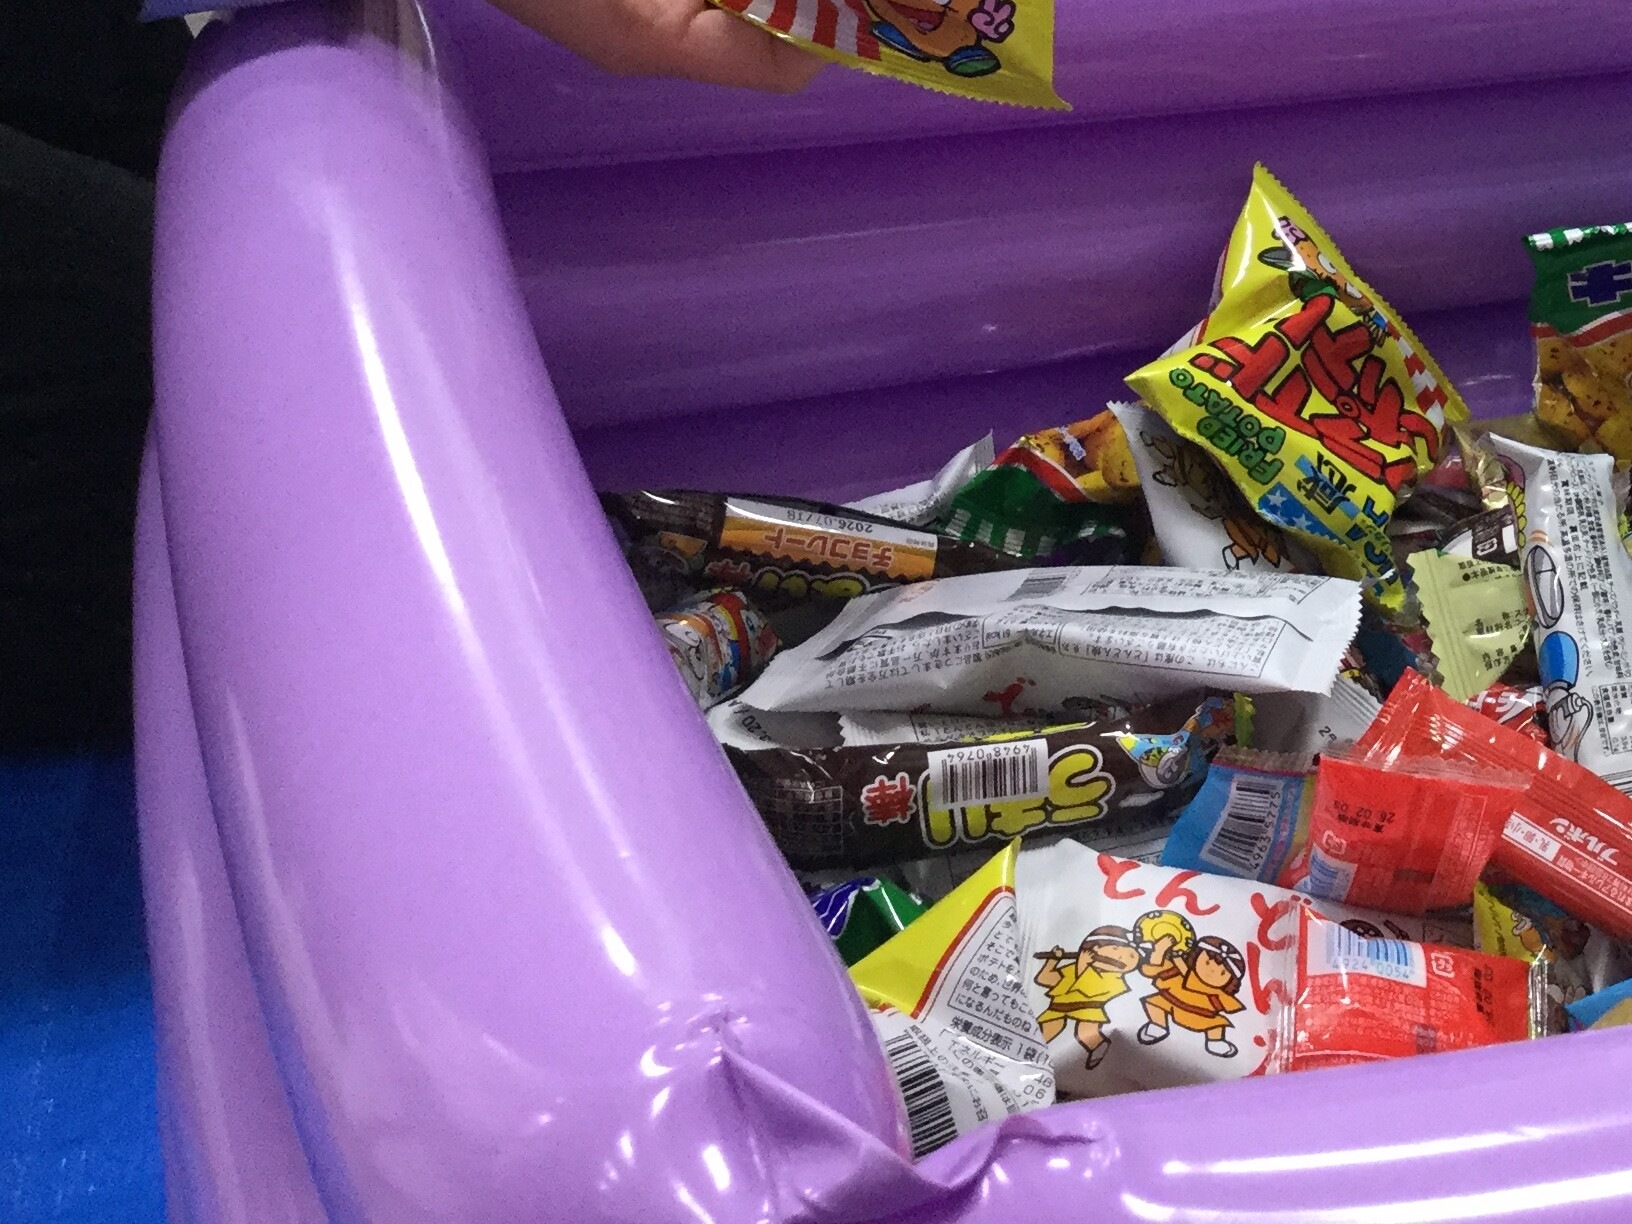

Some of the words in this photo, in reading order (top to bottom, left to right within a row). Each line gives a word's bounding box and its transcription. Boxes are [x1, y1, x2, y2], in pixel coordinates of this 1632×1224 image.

[1169, 368, 1286, 455] POTATO
[1197, 415, 1285, 485] FRIED
[764, 527, 893, 569] チョコレート
[947, 748, 984, 763] 0764
[993, 744, 1031, 758] 4948
[1546, 813, 1624, 868] ブルボン
[949, 1016, 1014, 1051] 栄養成分表示
